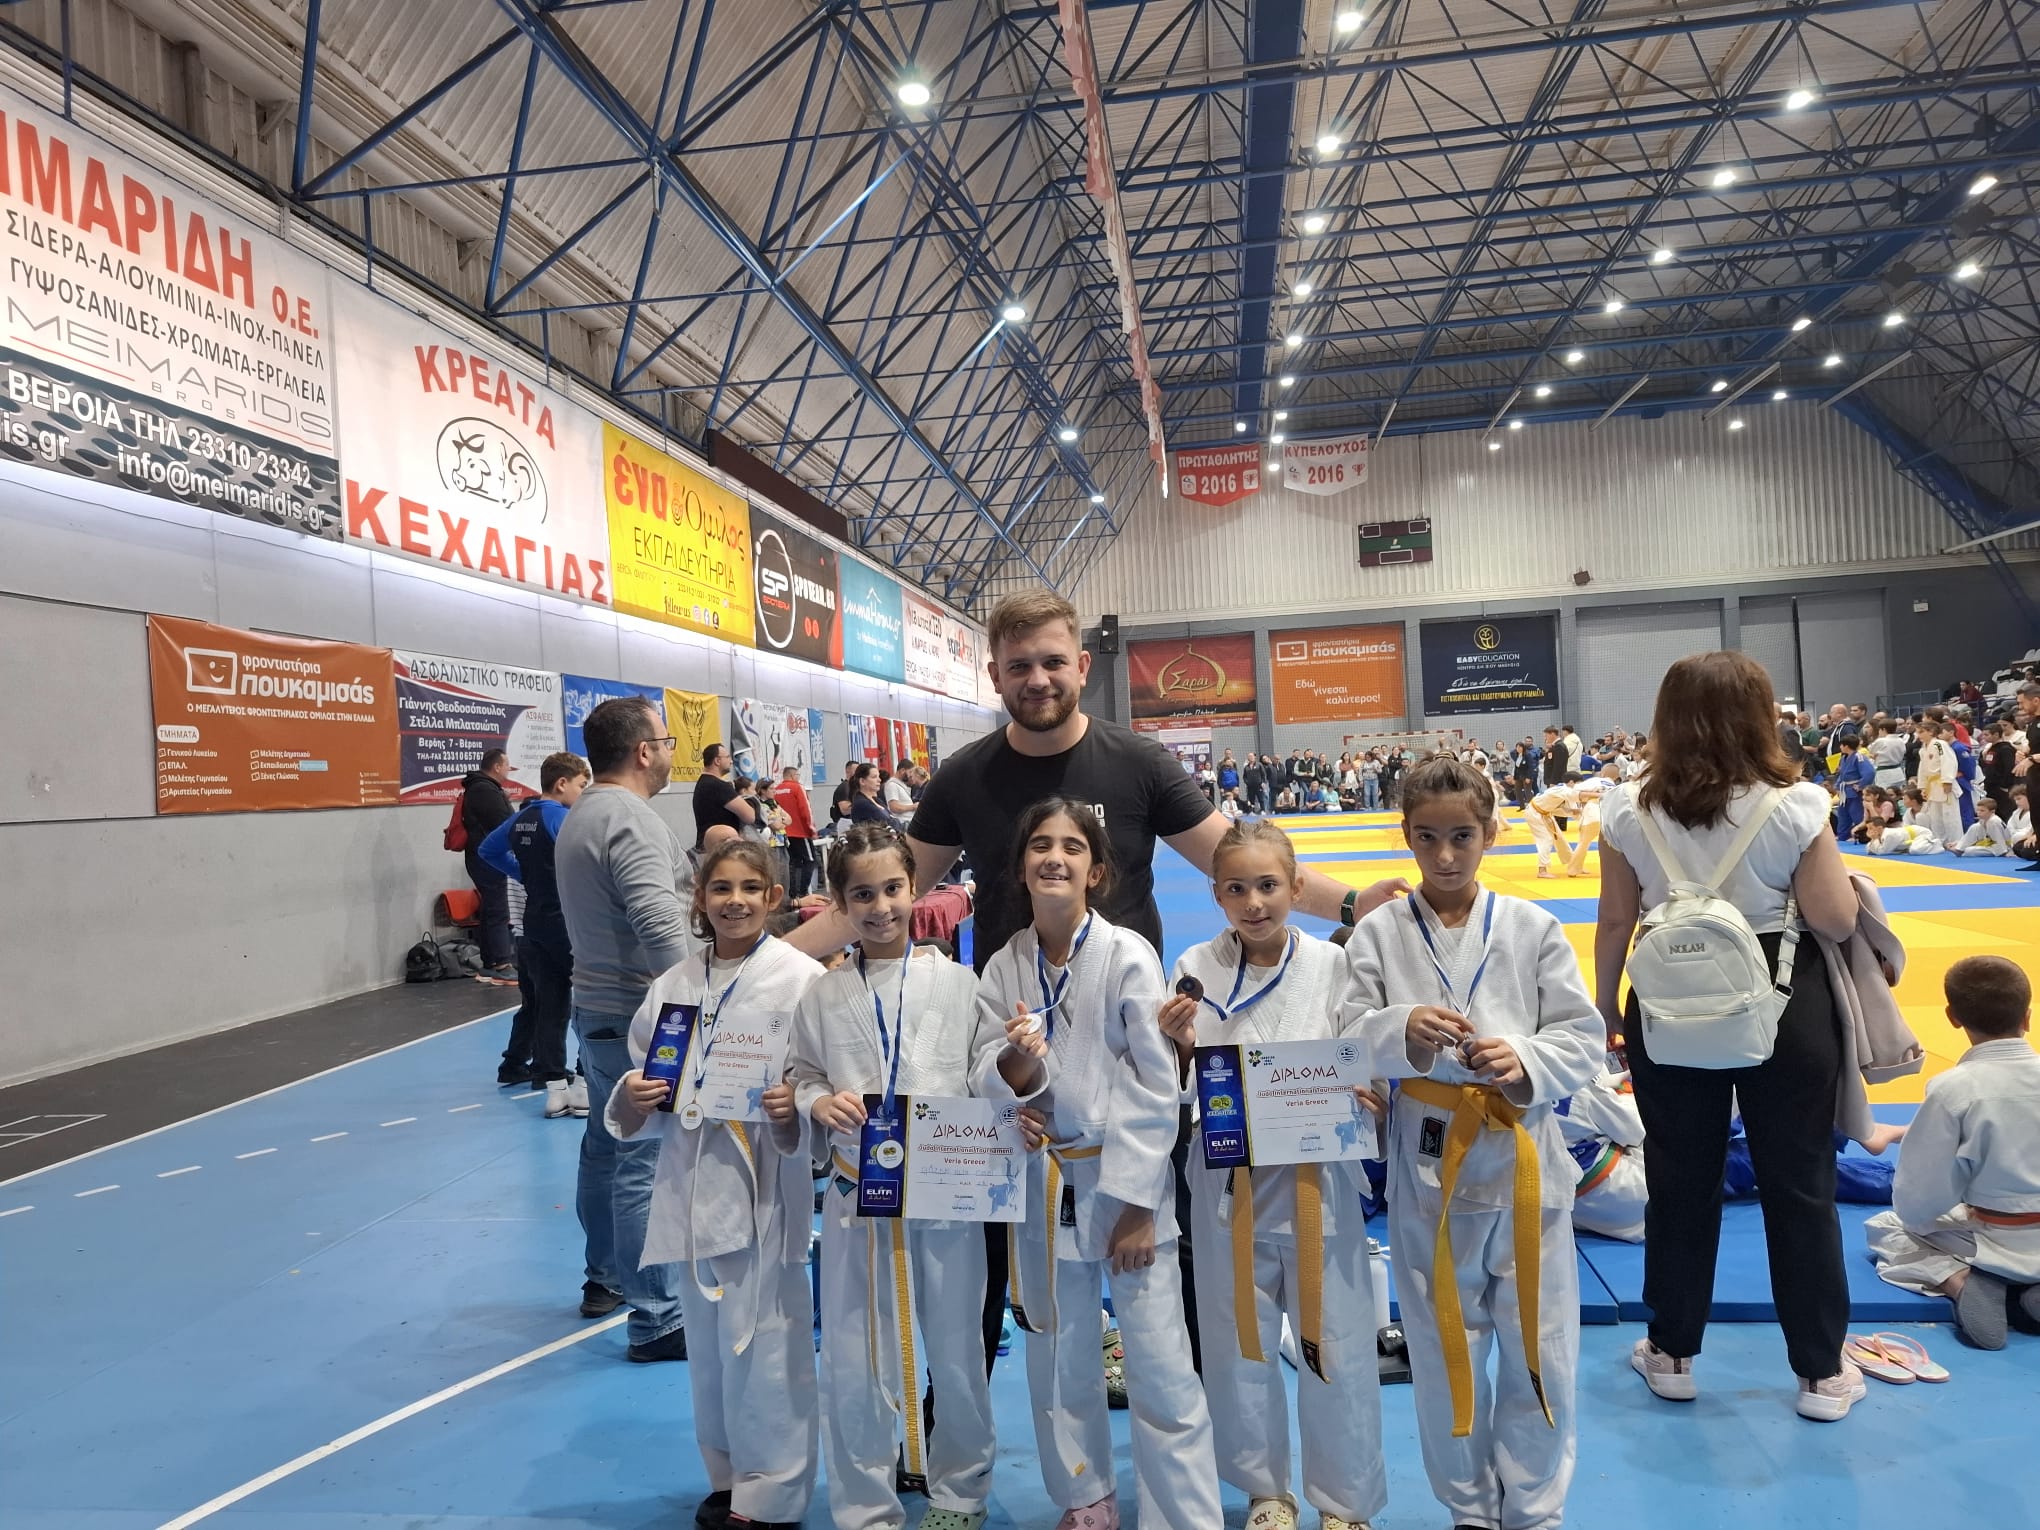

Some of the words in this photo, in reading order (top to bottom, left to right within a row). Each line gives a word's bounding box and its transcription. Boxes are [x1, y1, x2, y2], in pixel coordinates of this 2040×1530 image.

[8, 296, 331, 438] MEIMARIDIS
[414, 345, 555, 450] ΚΡΕΑΤΑ
[0, 411, 70, 461] is.gr
[8, 368, 124, 433] ΒΕΡΟΙΑ
[130, 408, 182, 451] ΤΗΛ
[188, 428, 251, 471] 23310
[256, 450, 312, 489] 23342
[1178, 450, 1259, 468] ΠΡΩΤΑΘΛΗΤΗΣ
[1201, 474, 1237, 495] 2016
[1308, 464, 1344, 485] 2016
[118, 445, 325, 530] info@meimaridis.gr
[345, 479, 609, 605] ΚΕΧΑΓΙΑΣ
[633, 526, 737, 592] ΕΚΠΑΙΔΕΥΤΗΡΙΑ
[1312, 642, 1396, 658] πουκαμισάς
[242, 655, 321, 674] φροντιστήρια
[410, 660, 499, 688] ΑΣΦΑΛΙΣΤΙΚΟ
[505, 671, 553, 693] ΓΡΑΦΕΙΟ
[1295, 679, 1316, 689] Εδώ
[241, 674, 375, 707] πουκαμισάς
[1313, 685, 1348, 697] γίνεσαι
[1326, 693, 1380, 705] καλύτερος!
[195, 704, 246, 716] ΜΕΓΑΛΥΤΕΡΟΣ
[247, 706, 309, 719] ΦΡΟΝΤΙΣΤΗΡΙΑΚΟΣ
[309, 710, 336, 721] ΟΜΙΛΟΣ
[400, 697, 436, 713] Γιάννης
[437, 700, 506, 718] Θεοδοσόπουλος
[159, 729, 198, 739] ΤΜΗΜΑΤΑ
[409, 716, 444, 729] Στέλλα
[445, 718, 500, 734] Μπλατσιώτη
[449, 738, 454, 748] 7
[962, 1158, 986, 1166] Greece
